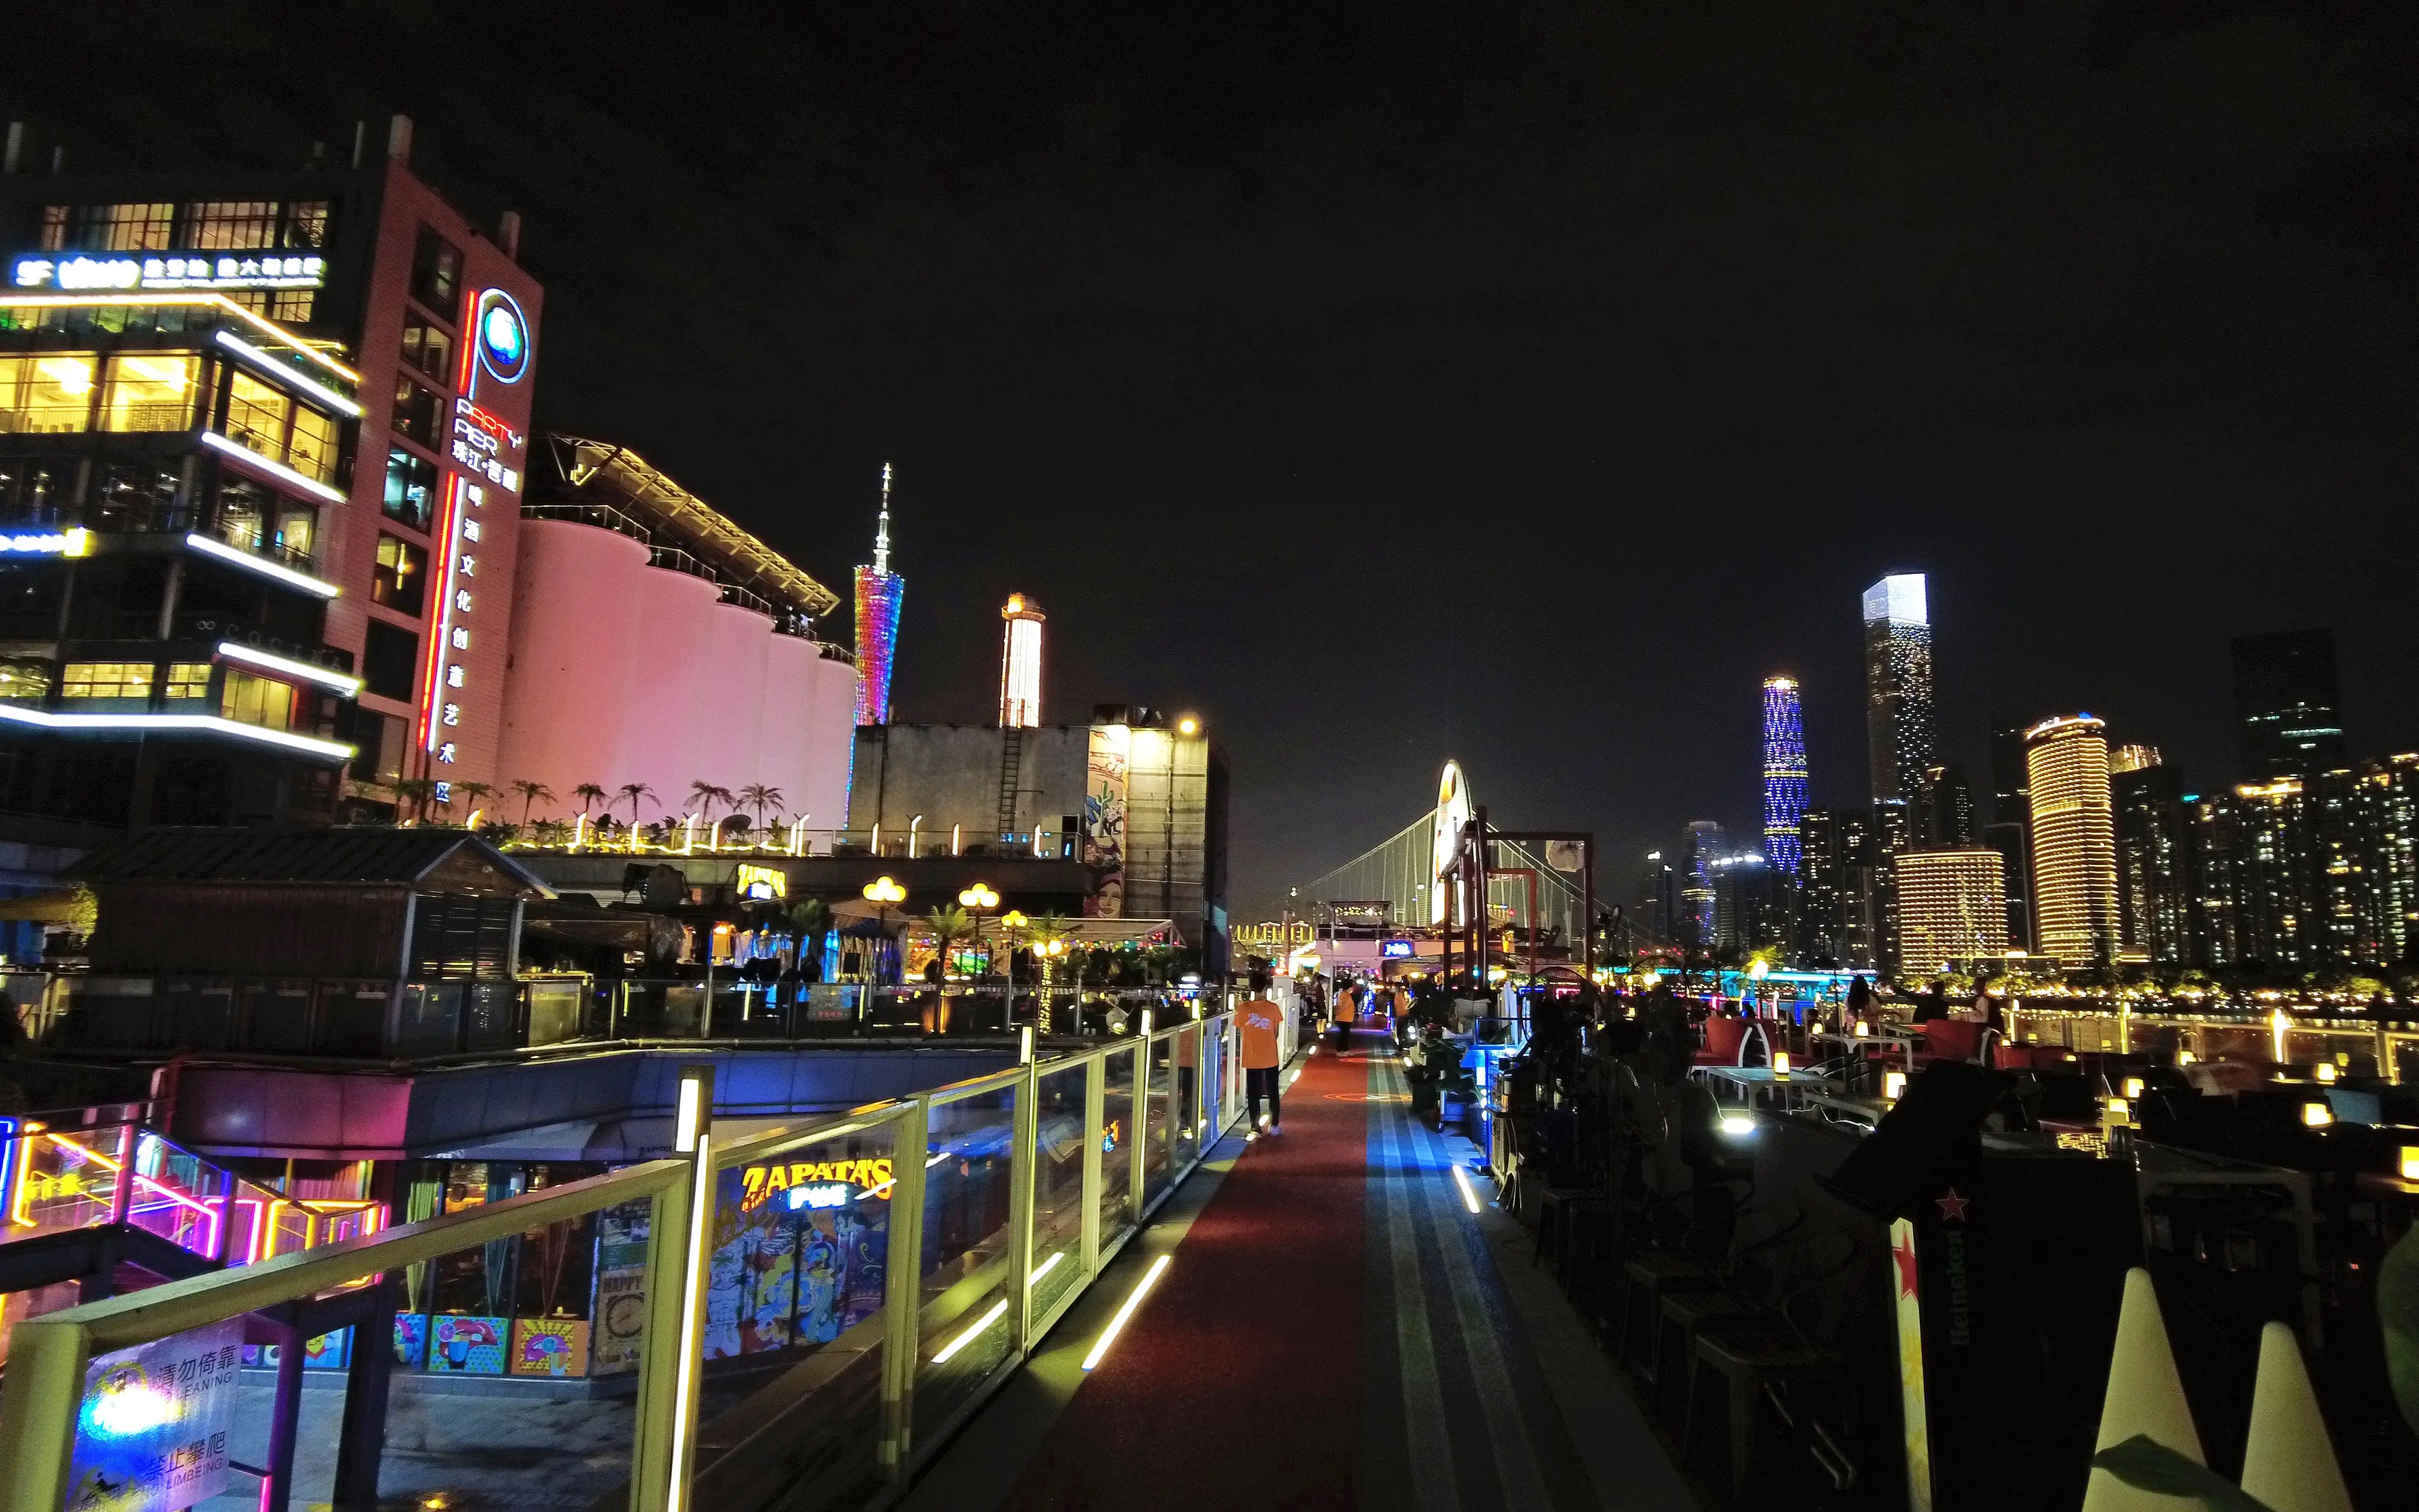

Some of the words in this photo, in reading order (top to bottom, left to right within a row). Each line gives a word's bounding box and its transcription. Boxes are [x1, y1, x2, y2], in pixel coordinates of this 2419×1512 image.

[453, 398, 522, 449] PARTY
[742, 1159, 892, 1200] ZAPATA'S
[1945, 1230, 1970, 1346] Heineken
[157, 1345, 236, 1389] 请勿倚靠
[144, 1431, 225, 1482] 禁止攀爬
